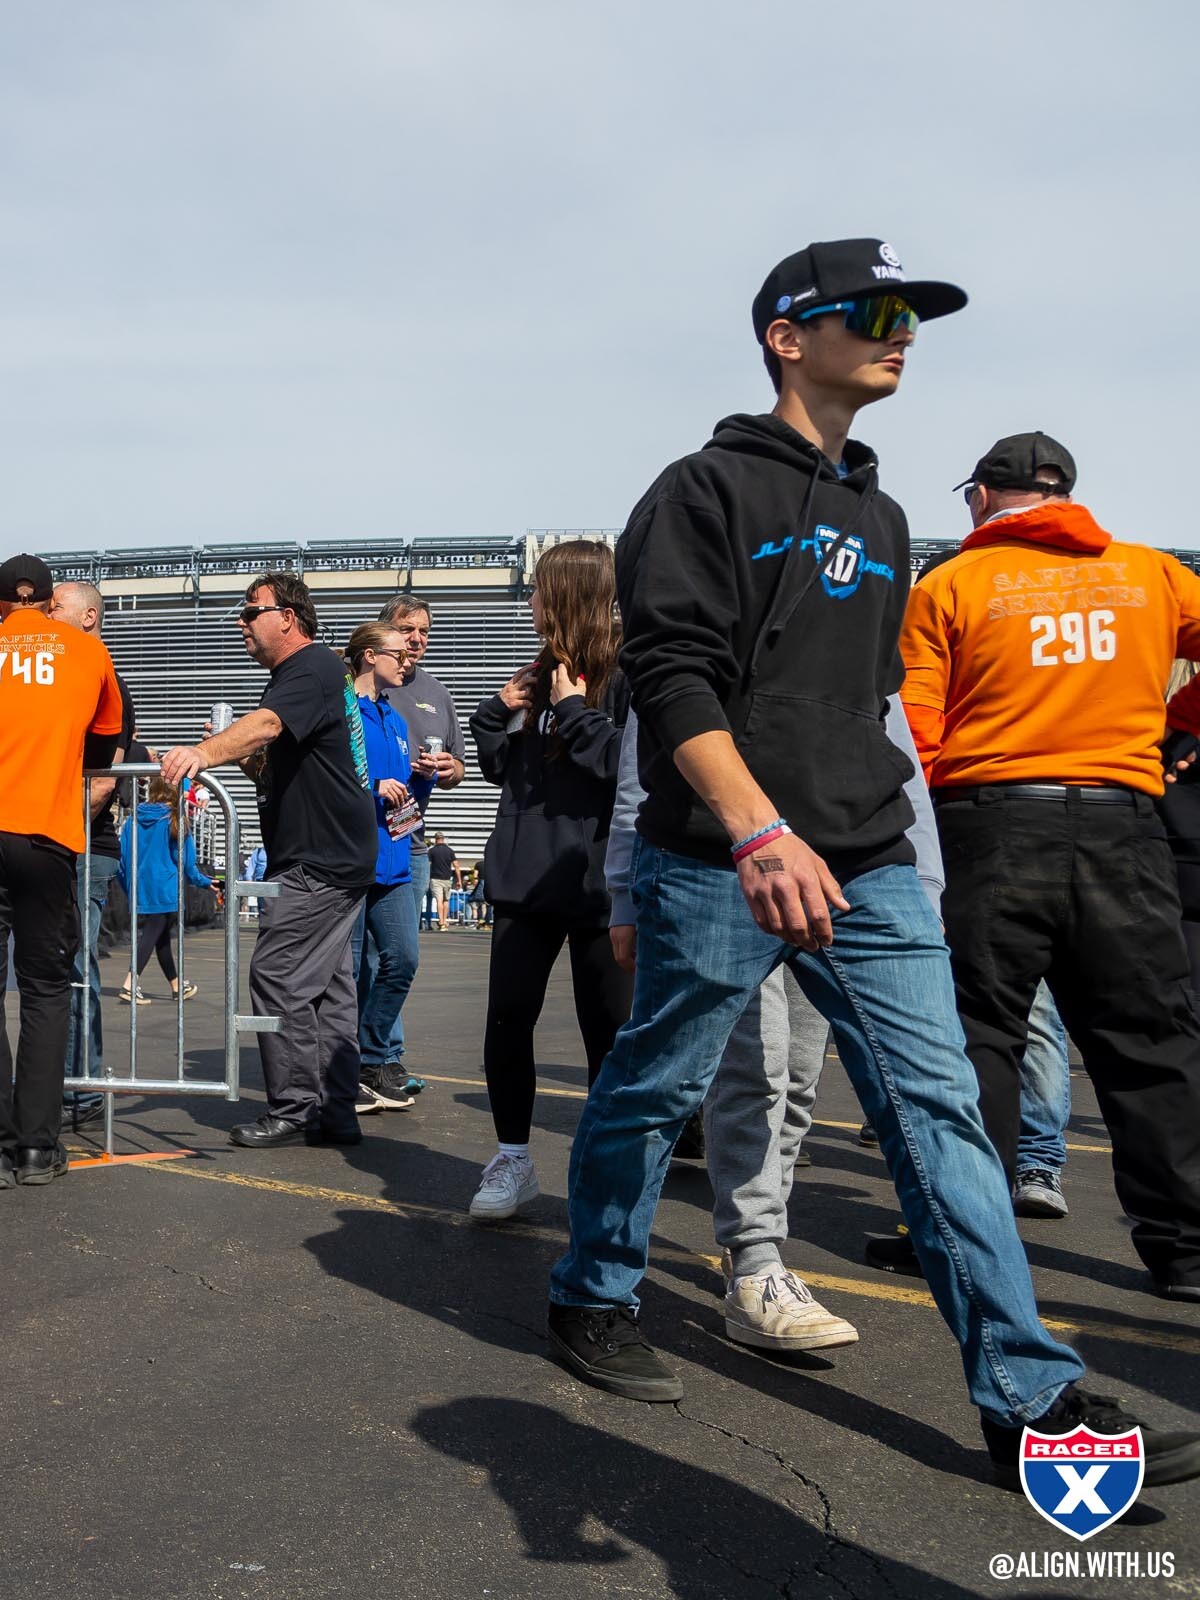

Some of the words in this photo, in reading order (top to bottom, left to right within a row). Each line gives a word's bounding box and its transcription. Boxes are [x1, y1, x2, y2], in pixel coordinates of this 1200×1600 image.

[992, 562, 1128, 592] SAFETY
[988, 586, 1147, 619] SERVICES
[1030, 609, 1116, 667] 296
